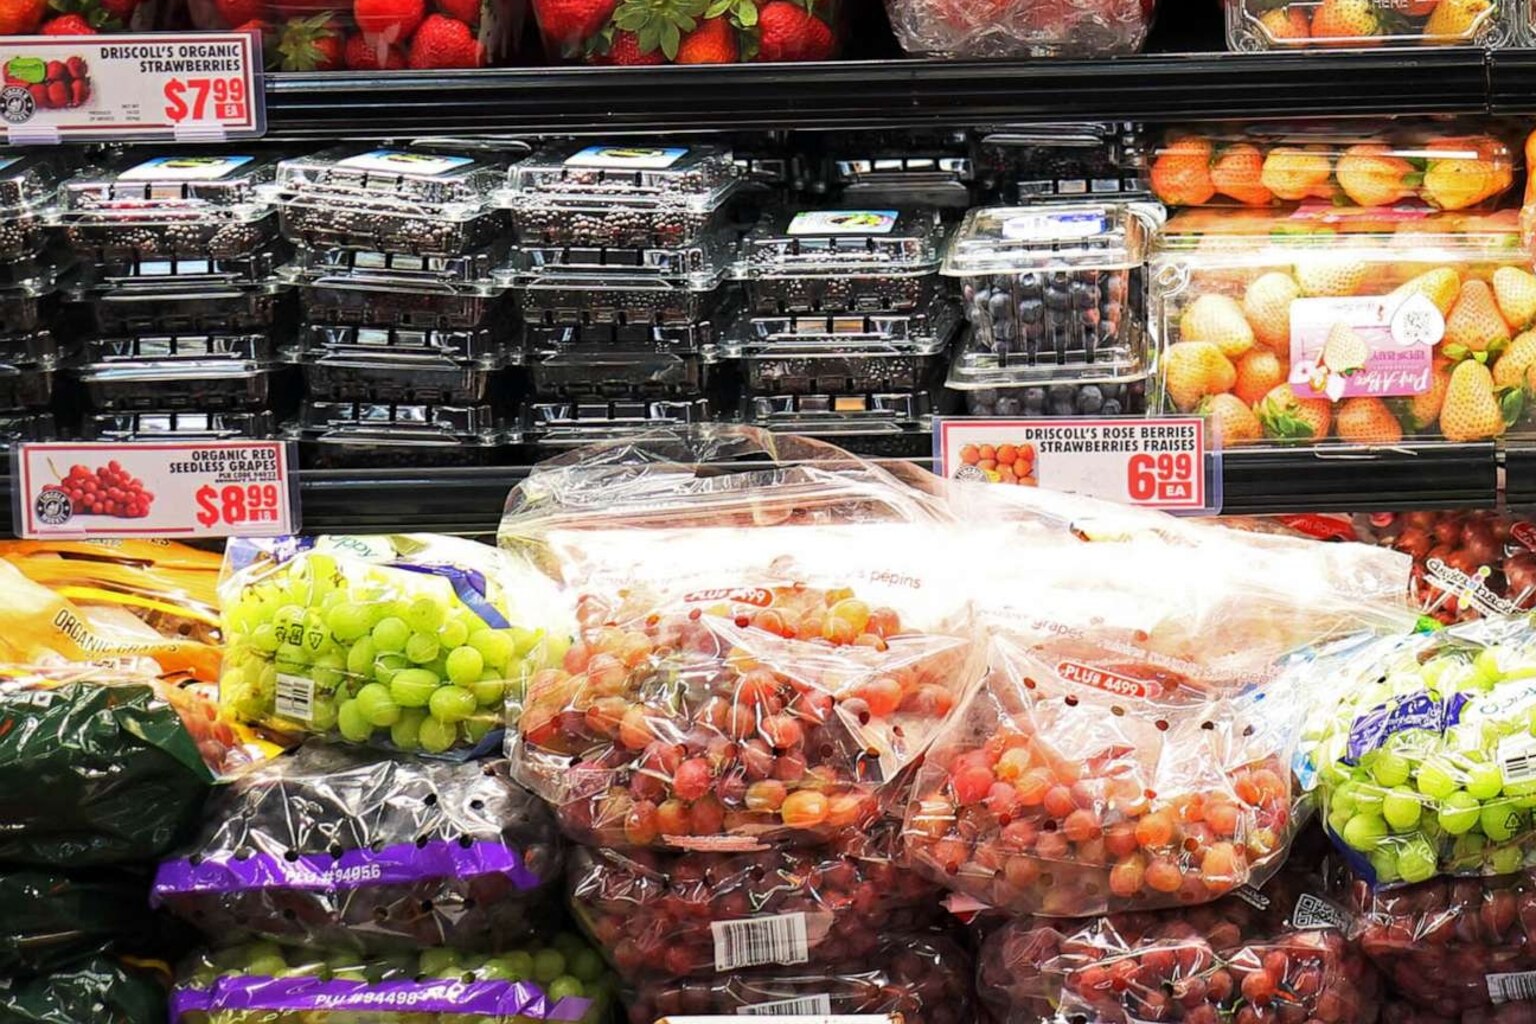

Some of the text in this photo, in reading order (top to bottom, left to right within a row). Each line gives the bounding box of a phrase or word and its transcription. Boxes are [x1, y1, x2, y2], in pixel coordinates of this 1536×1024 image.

[100, 44, 239, 60] DRISCOLL'S ORGANIC
[140, 59, 241, 73] STRAWBERRIES
[1025, 426, 1195, 440] DRISCOLL'S ROSE BERRIES
[1039, 439, 1195, 453] STRAWBERRIES FRAISES
[192, 449, 276, 461] ORGANIC RED
[169, 460, 277, 474] SEEDLESS GRAPES
[1165, 485, 1186, 496] EA
[53, 608, 112, 654] ORGANIC
[1031, 619, 1085, 641] grapes
[1104, 675, 1138, 696] 4499
